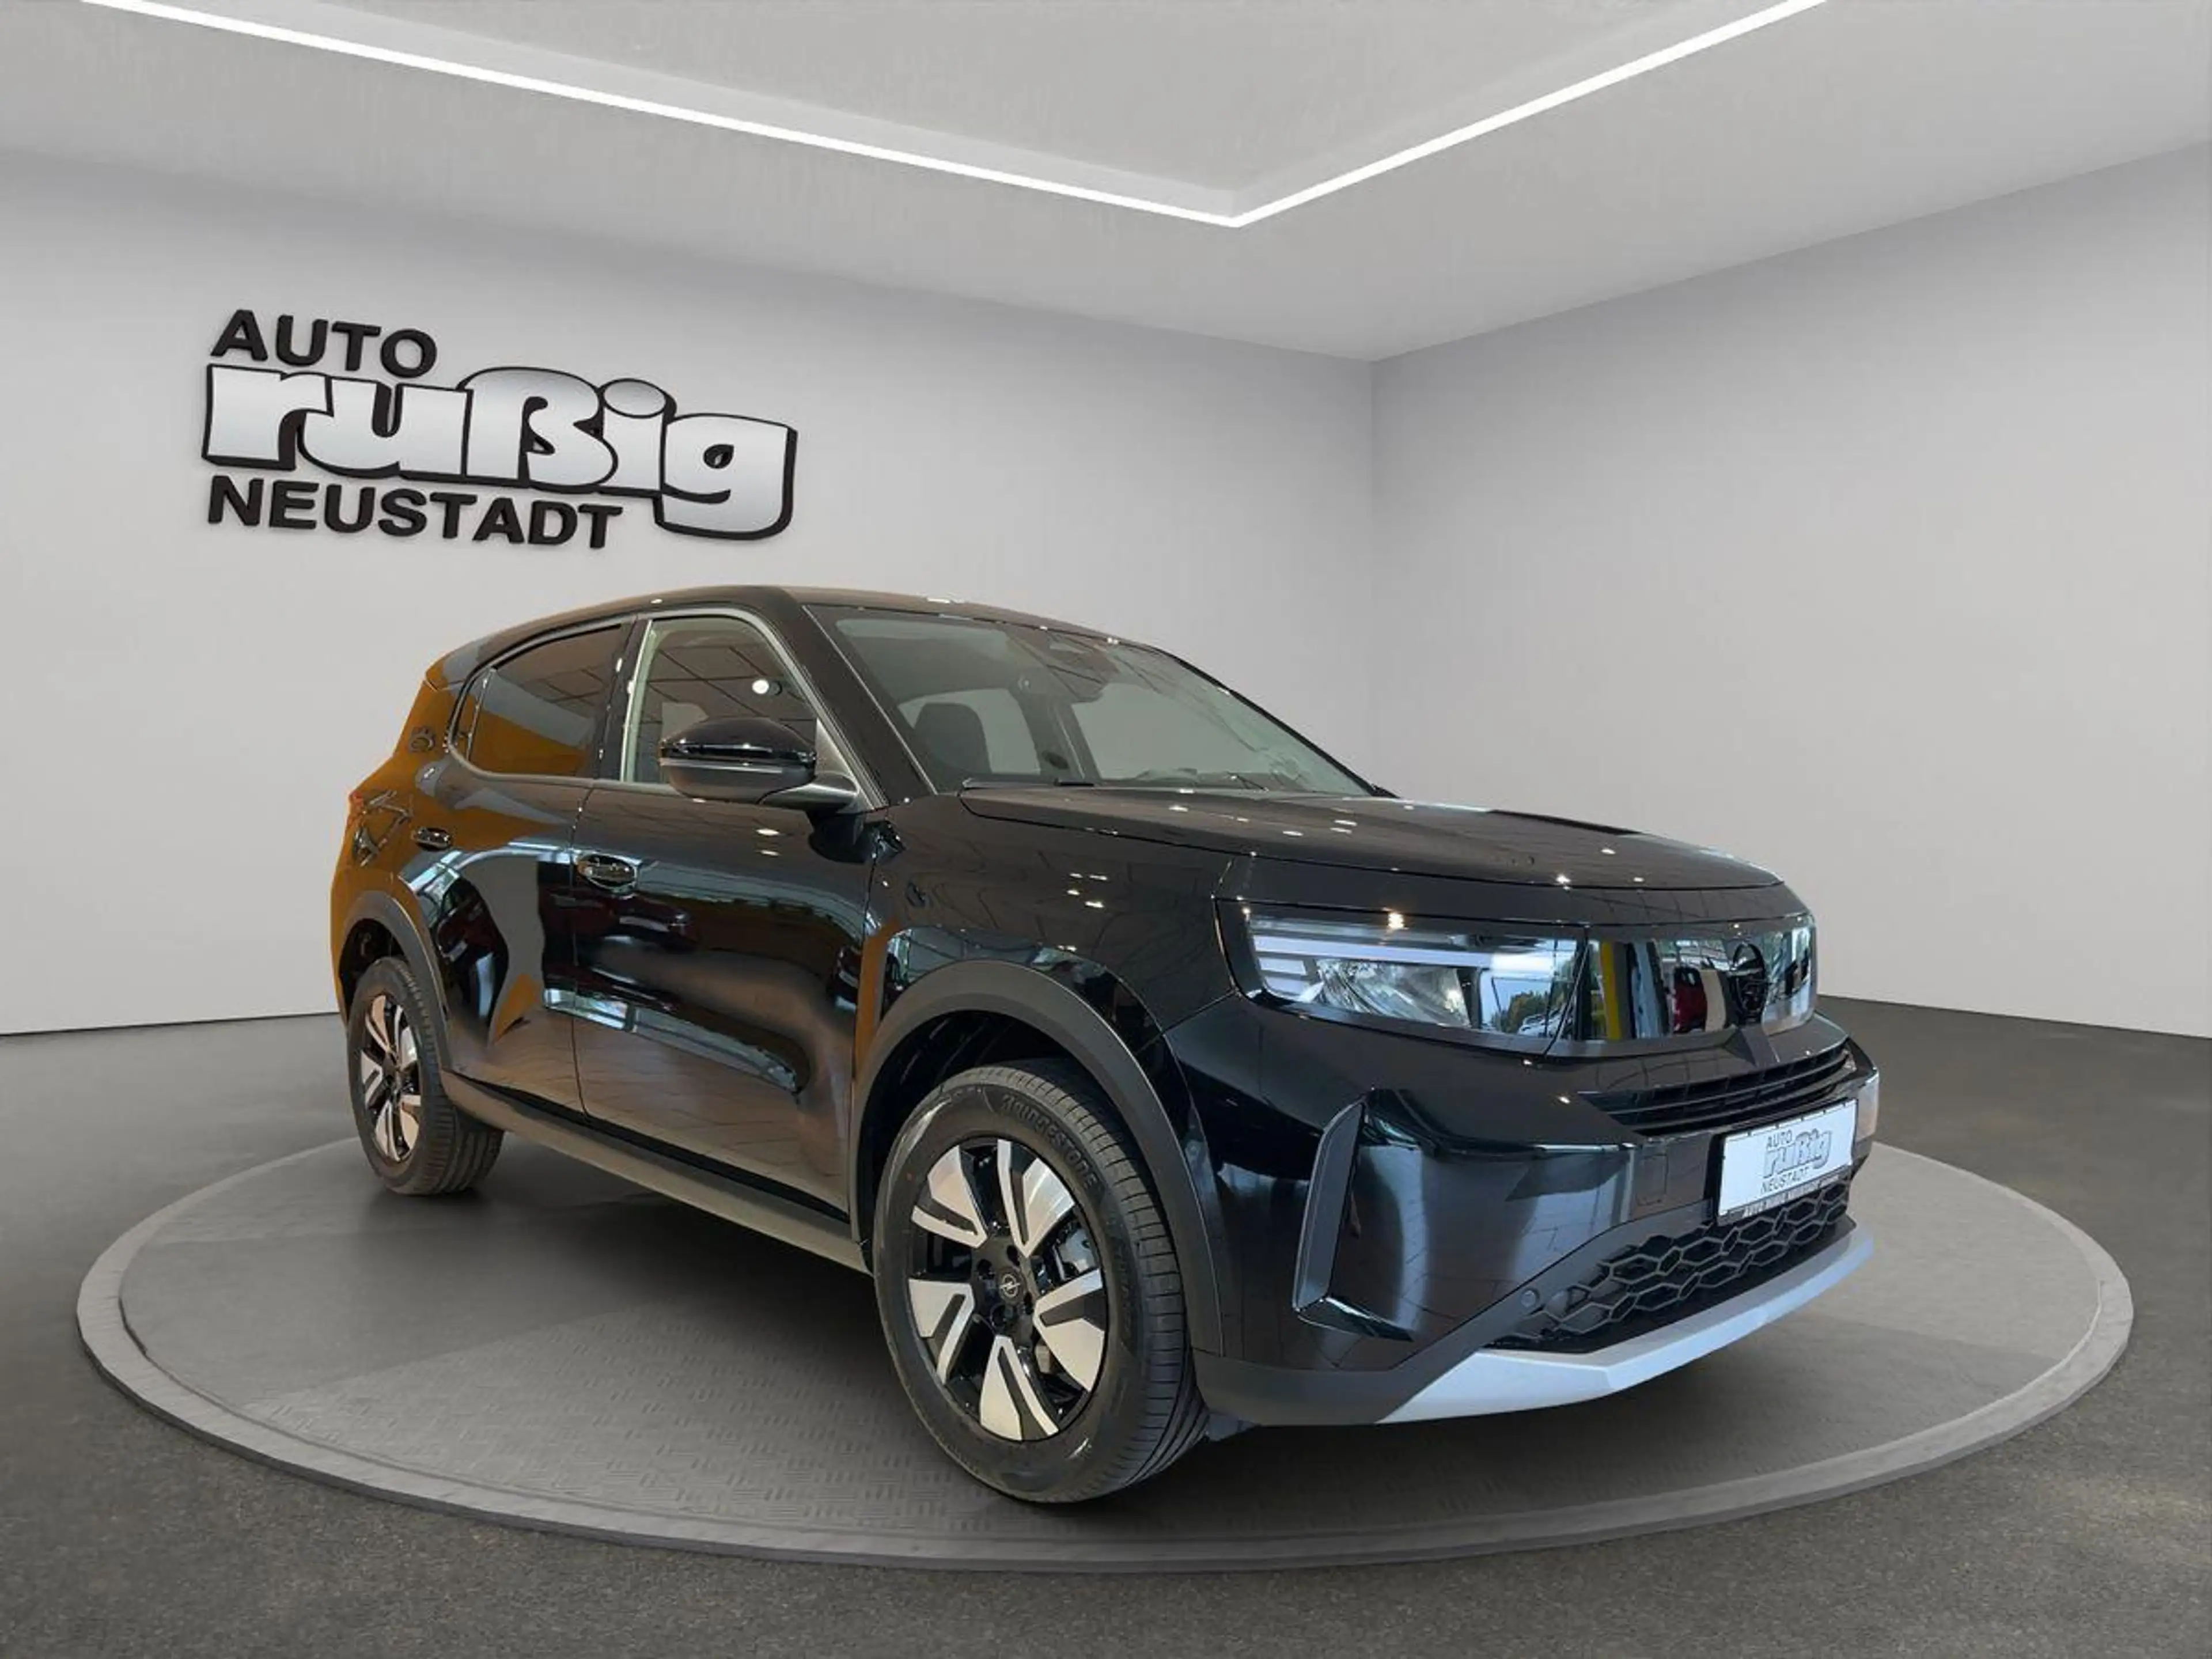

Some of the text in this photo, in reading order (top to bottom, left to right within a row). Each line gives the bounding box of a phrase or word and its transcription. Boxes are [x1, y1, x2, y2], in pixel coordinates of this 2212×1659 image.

[210, 309, 438, 378] AUTO
[202, 363, 798, 541] rußig
[207, 475, 623, 550] NEUSTADT
[1766, 1129, 1793, 1149] AUTO
